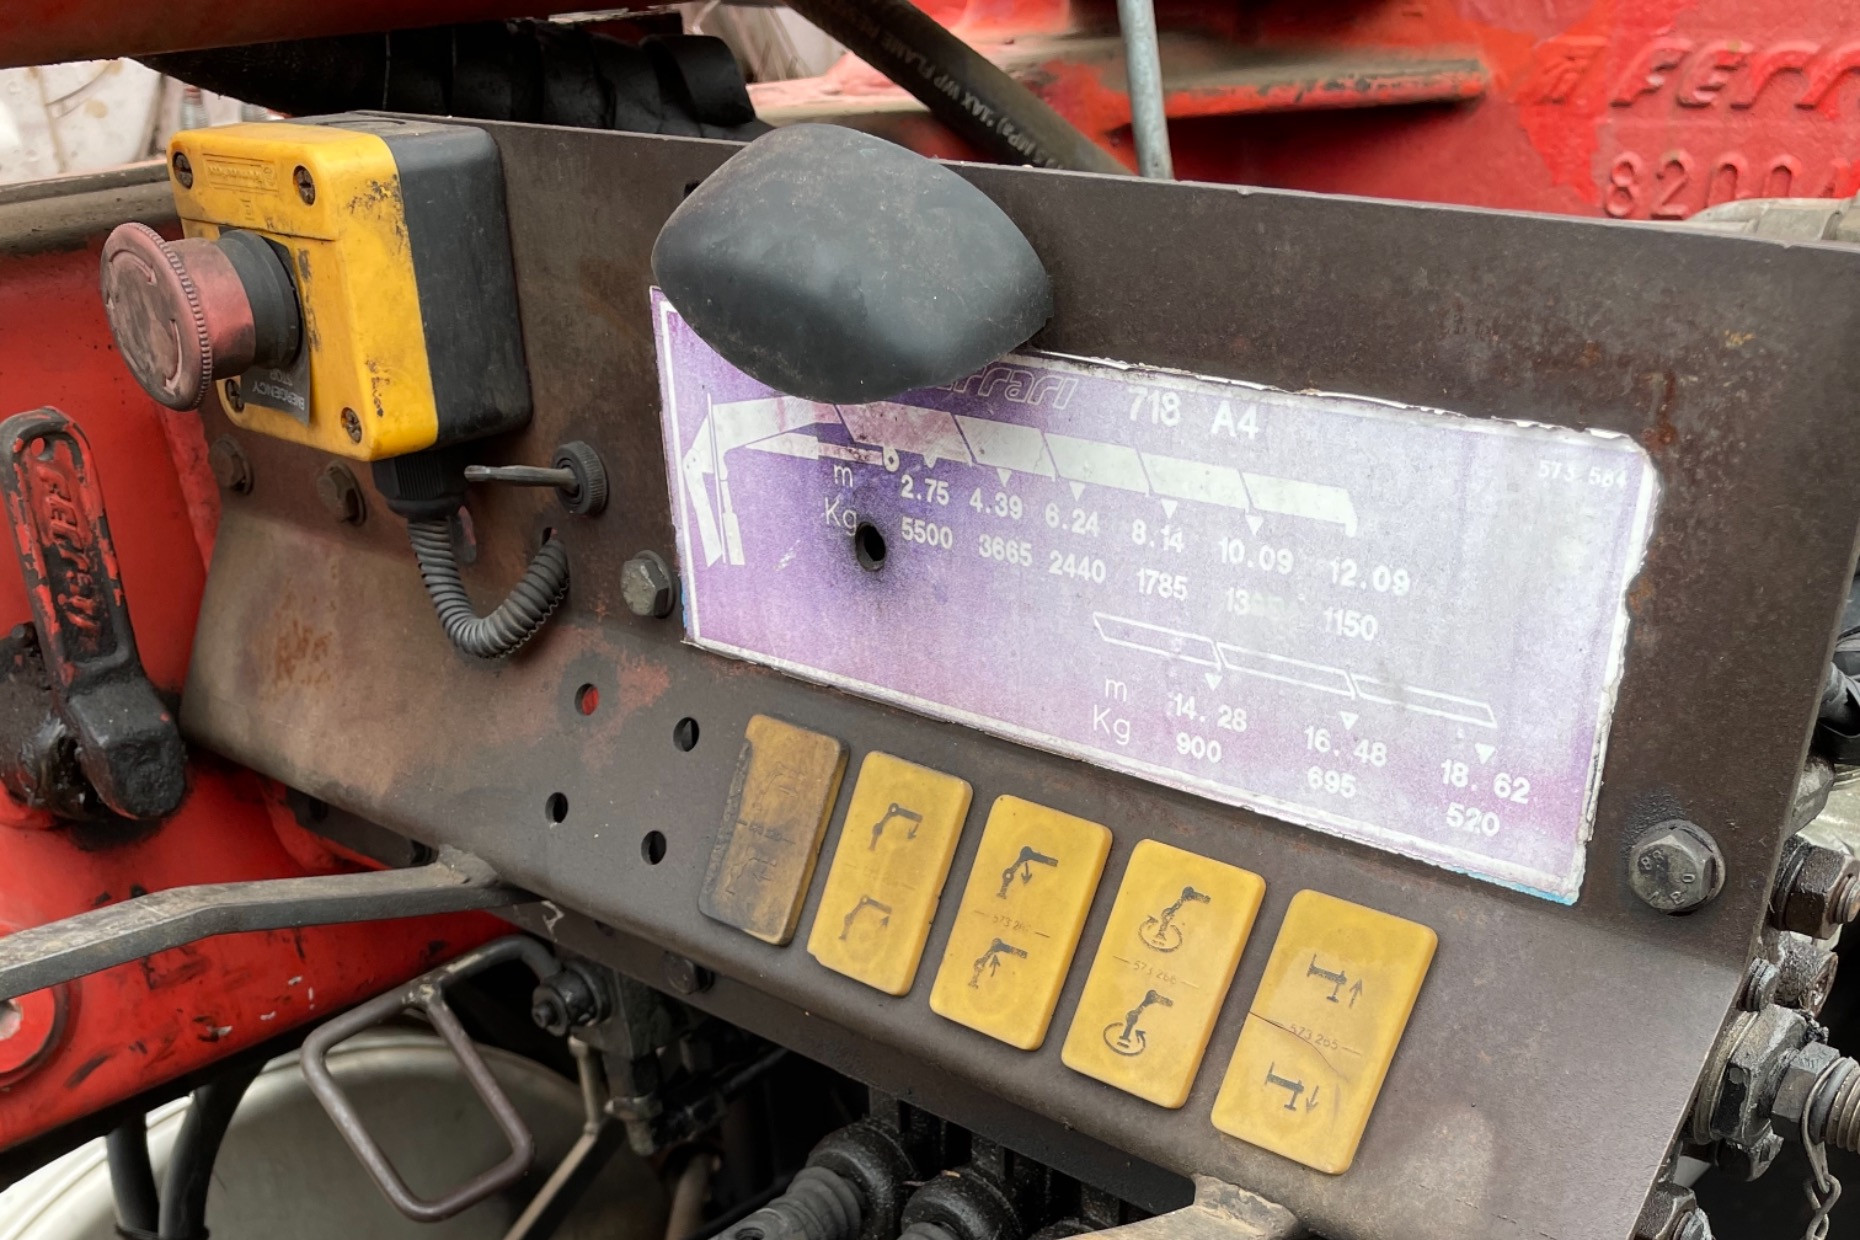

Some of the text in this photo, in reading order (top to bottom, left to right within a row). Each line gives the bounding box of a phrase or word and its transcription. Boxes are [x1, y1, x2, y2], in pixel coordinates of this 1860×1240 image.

[937, 366, 1078, 410] rrari
[1127, 387, 1260, 440] 718 A4
[824, 495, 857, 536] Kg
[901, 516, 953, 549] 5500
[978, 534, 1032, 567] 3665
[1049, 549, 1106, 584] 2440
[1136, 567, 1189, 600] 1785
[1324, 606, 1378, 641] 1150
[833, 463, 1410, 597] m 2.75 4.39 6.24 8.14 10.09 12.09
[1105, 677, 1128, 702] m
[1092, 704, 1501, 837] Kg 900 695 520
